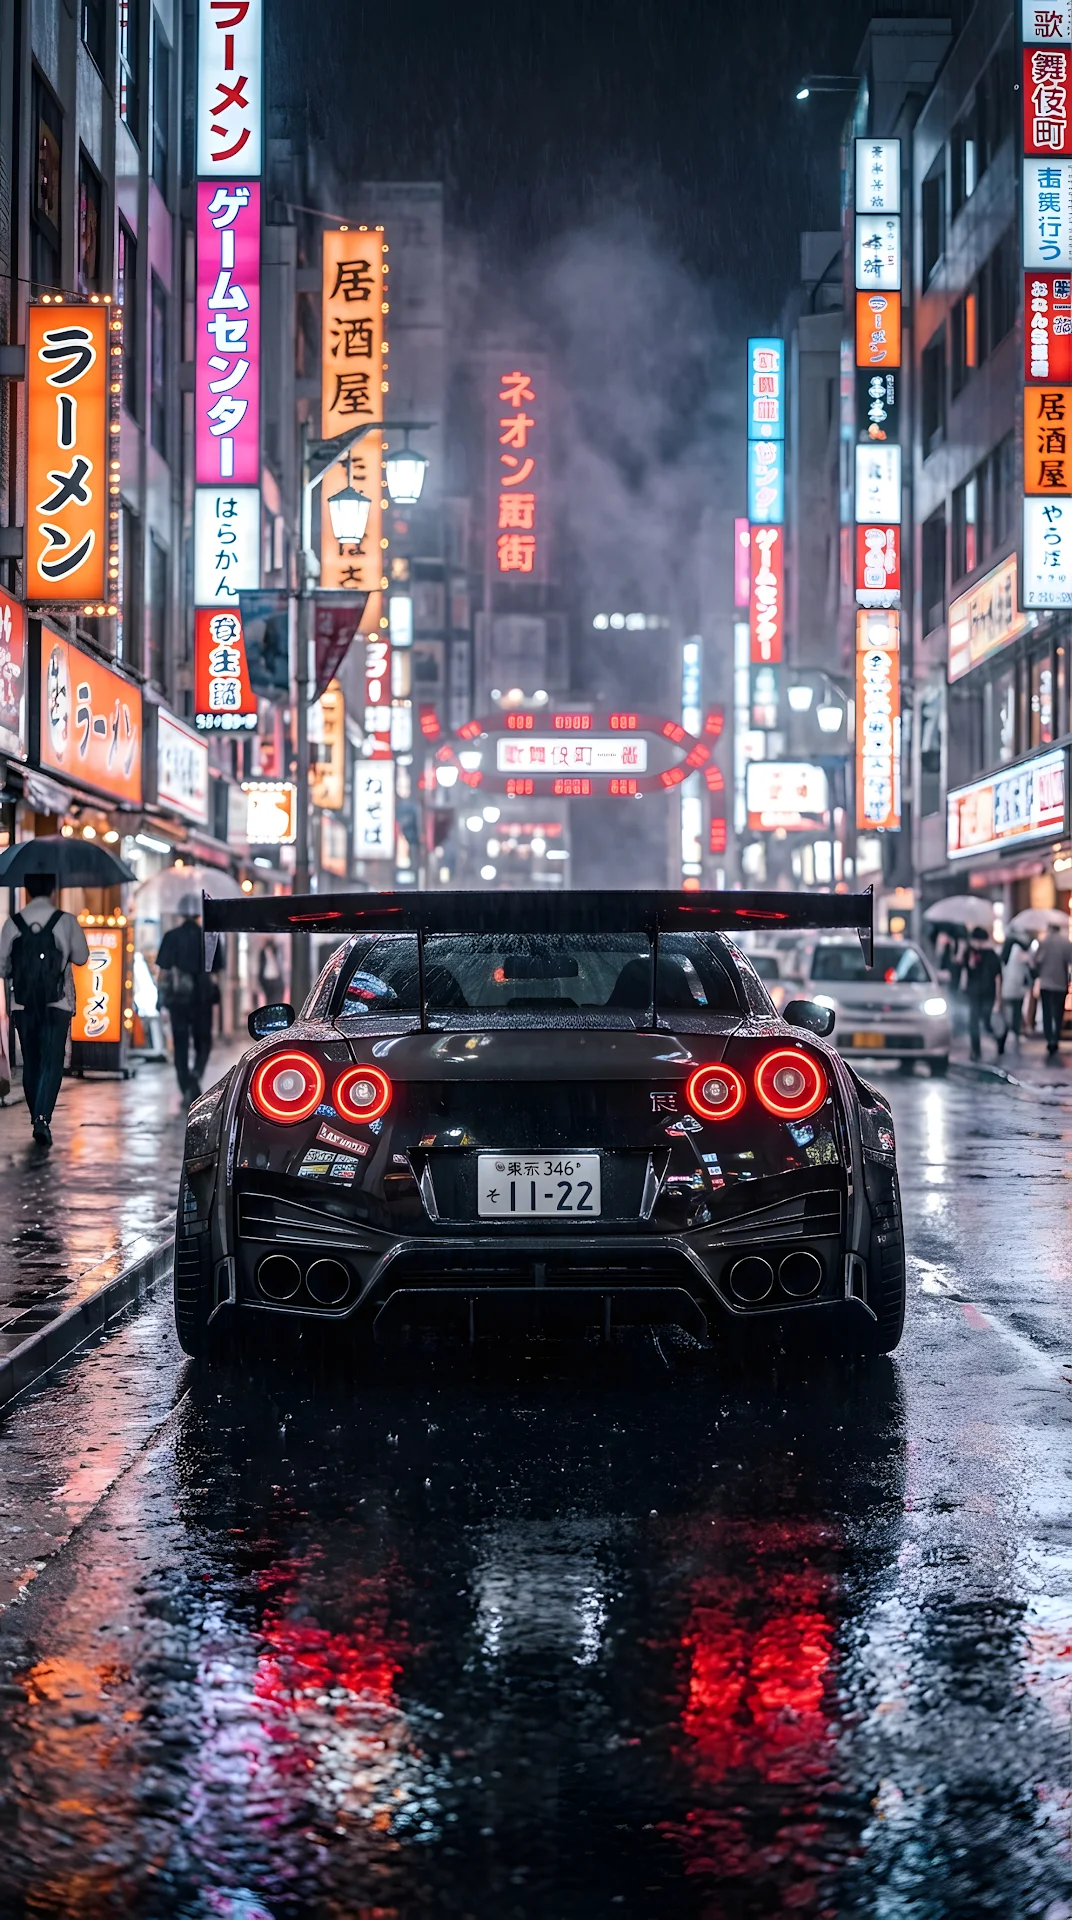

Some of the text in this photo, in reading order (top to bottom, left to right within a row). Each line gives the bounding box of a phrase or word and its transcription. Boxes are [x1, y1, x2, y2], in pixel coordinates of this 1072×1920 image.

[207, 186, 251, 478] ゲームセンター
[329, 259, 375, 415] 居酒屋
[36, 325, 97, 582] ラーメン
[1037, 393, 1068, 488] 居酒屋
[214, 496, 239, 598] はらかん
[75, 682, 138, 781] ラーメン
[510, 1180, 593, 1211] 11-22
[543, 1160, 574, 1176] 346
